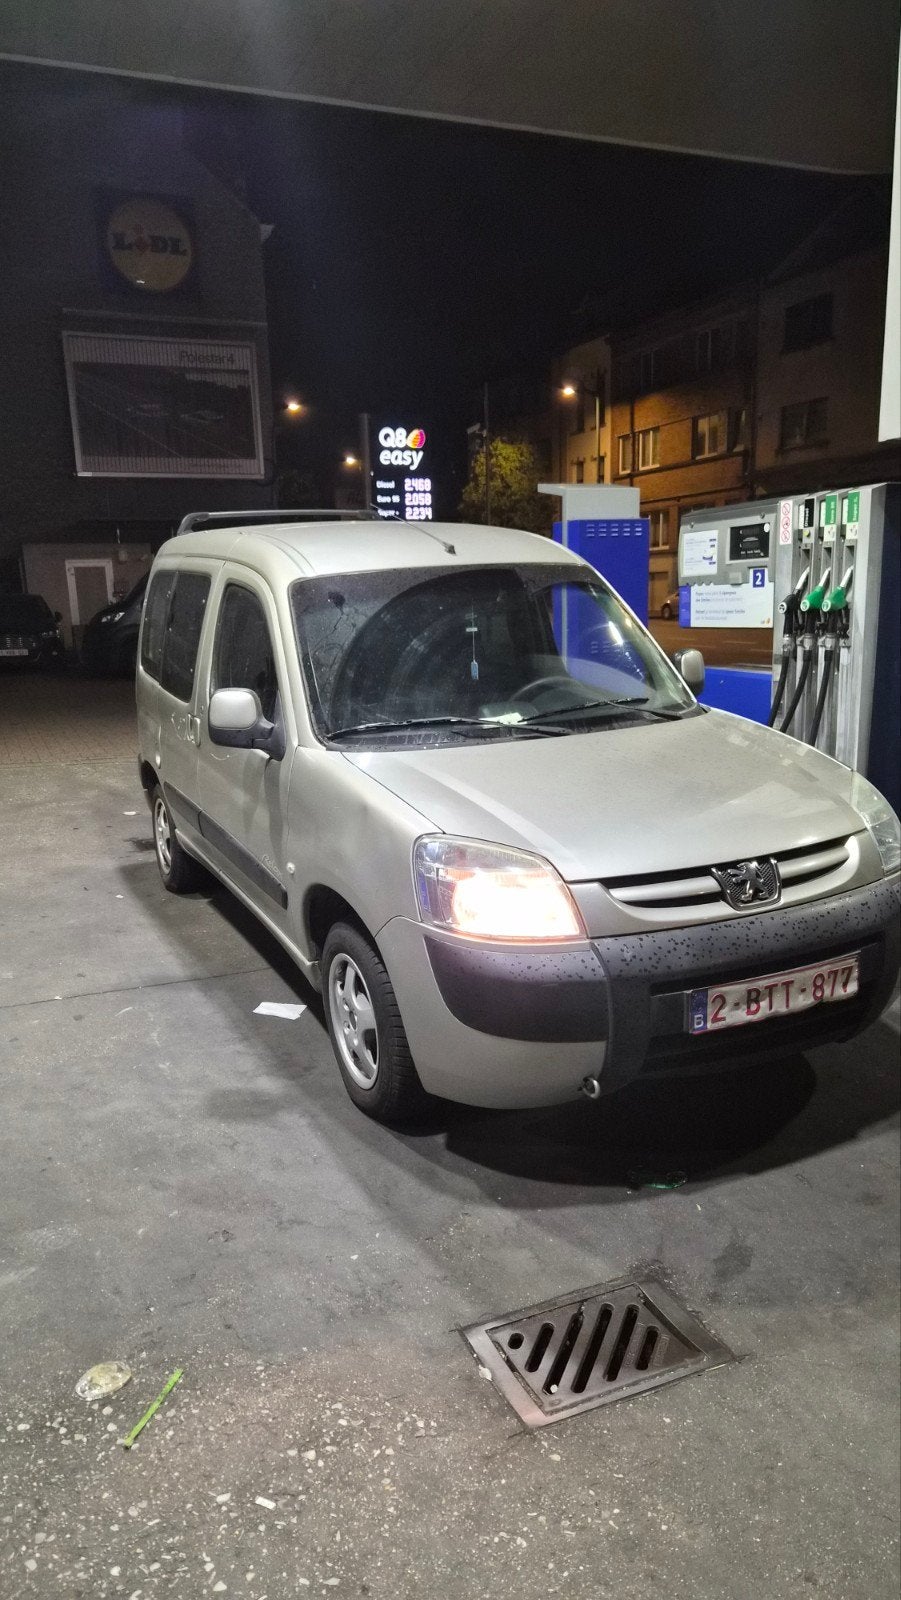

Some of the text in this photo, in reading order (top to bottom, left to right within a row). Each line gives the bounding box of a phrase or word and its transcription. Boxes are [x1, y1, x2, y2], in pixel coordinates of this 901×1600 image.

[378, 426, 407, 448] Q8
[379, 449, 424, 471] easy
[376, 494, 391, 503] Euro
[755, 572, 762, 585] 2
[710, 965, 854, 1024] 2-BTT-877
[694, 1014, 704, 1028] B
